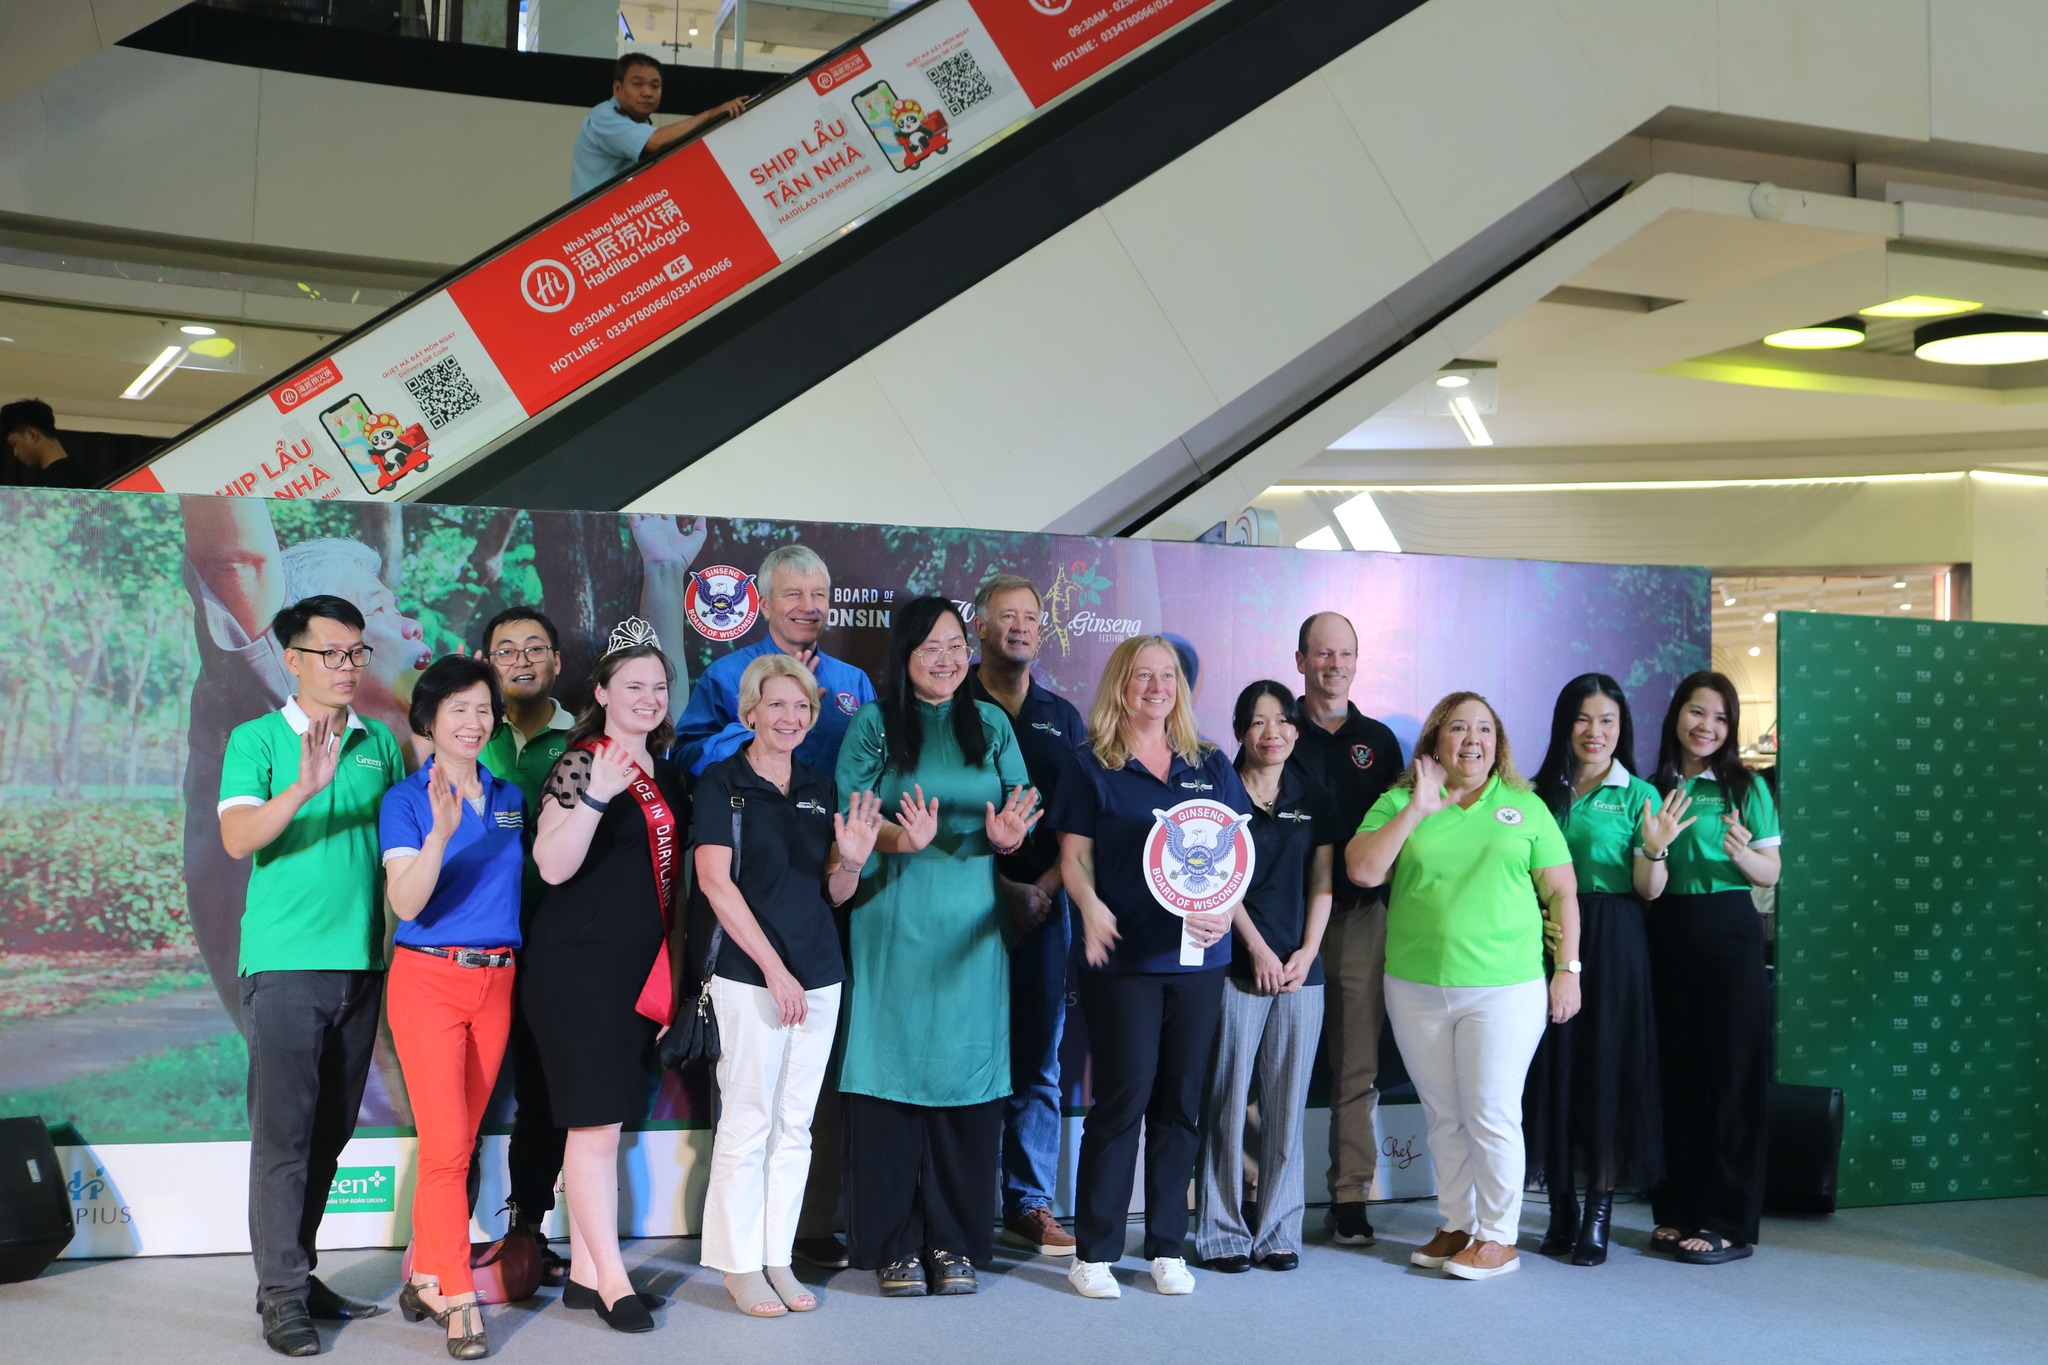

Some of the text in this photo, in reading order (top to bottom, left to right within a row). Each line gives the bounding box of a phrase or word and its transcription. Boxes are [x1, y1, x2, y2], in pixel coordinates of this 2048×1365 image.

[1068, 9, 1108, 38] 09:30AM
[1052, 38, 1098, 71] HOTLINE:
[750, 120, 846, 186] SHIP LẨU
[764, 142, 863, 208] TẬN NHÀ
[778, 197, 818, 224] HAIDILAO
[818, 188, 835, 200] Vạn
[855, 164, 872, 178] Mall
[562, 188, 669, 255] Nhà hàng lẩu Haidilao
[571, 198, 683, 277] 海底捞火锅
[583, 220, 691, 290] Haidilao Huǒguō
[569, 303, 616, 337] 09:30AM
[620, 272, 667, 306] 02:00AM
[670, 258, 687, 276] 4F
[550, 257, 733, 374] HOTLINE: 0334780066/0334790066
[433, 346, 449, 357] Code
[214, 440, 312, 496] HIP LẨU
[705, 568, 740, 578] GINSENG
[834, 588, 894, 604] BOARD OF
[688, 608, 706, 632] BOARD
[719, 610, 756, 638] WISCONSIN
[828, 608, 890, 628] ONSIN
[1068, 610, 1142, 638] Ginseng
[1916, 624, 1931, 633] TCS
[1897, 645, 1911, 654] TCS
[1916, 670, 1931, 679] TCS
[1896, 691, 1911, 700] TCS
[1916, 716, 1931, 725] TCS
[1896, 738, 1911, 746] TCS
[1916, 762, 1930, 772] TCS
[1896, 784, 1910, 793] TCS
[650, 803, 666, 820] IN
[1178, 808, 1226, 824] GINSENG
[1915, 809, 1930, 818] TCS
[1896, 830, 1910, 840] TCS
[1915, 855, 1930, 864] TCS
[656, 824, 674, 907] DAIRYLAND
[1895, 877, 1910, 886] TCS
[1152, 867, 1244, 910] BOARD OF WISCONSIN
[1915, 902, 1929, 910] TCS
[1894, 924, 1909, 933] TCS
[1914, 948, 1929, 957] TCS
[1894, 971, 1908, 980] TCS
[1914, 995, 1928, 1004] TCS
[1894, 1017, 1908, 1026] TCS
[1913, 1041, 1928, 1050] TCS
[1893, 1064, 1907, 1073] TCS
[1912, 1088, 1927, 1097] TCS
[1892, 1111, 1906, 1120] TCS
[1912, 1134, 1926, 1144] TCS
[1382, 1136, 1422, 1170] Chef
[1891, 1158, 1906, 1167] TCS
[1911, 1181, 1925, 1190] TCS
